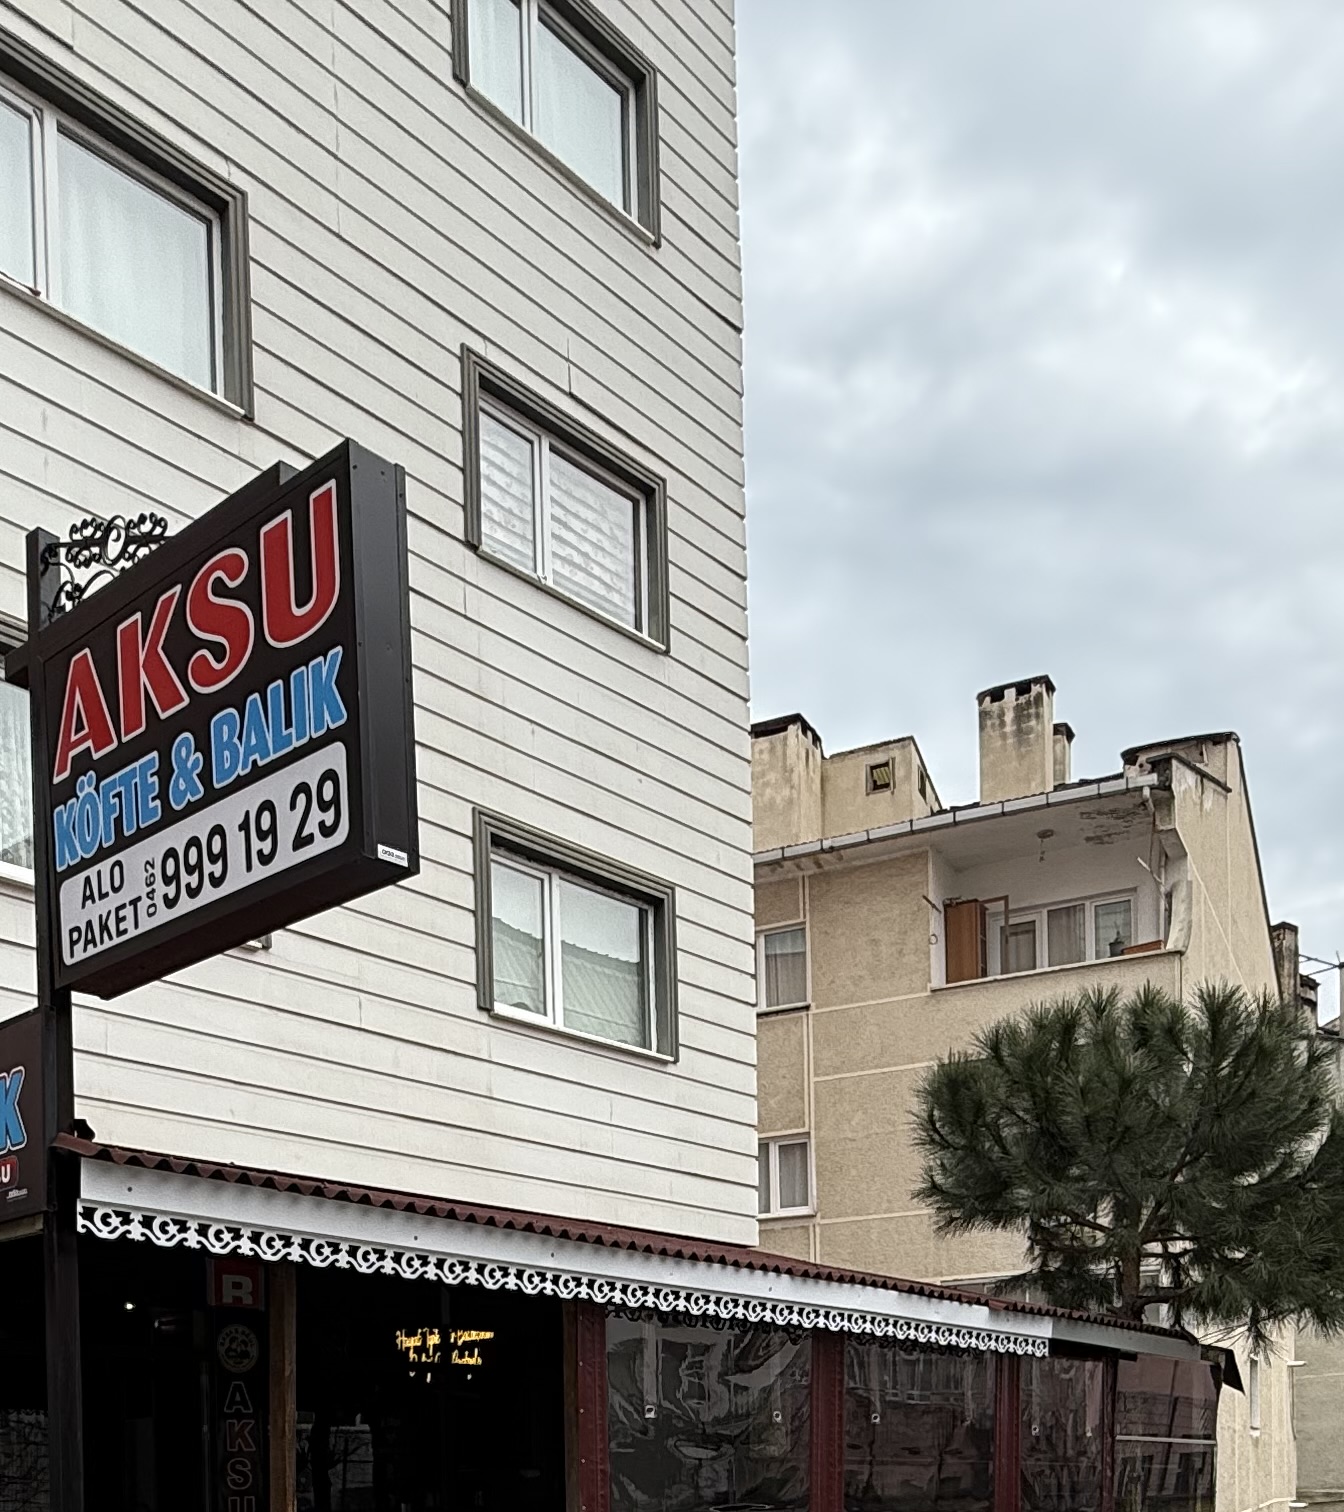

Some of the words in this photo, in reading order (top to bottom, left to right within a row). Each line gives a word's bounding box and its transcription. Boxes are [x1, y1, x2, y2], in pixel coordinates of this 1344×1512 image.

[53, 479, 342, 784] AKSU
[53, 750, 161, 873] KÖFTE
[170, 731, 203, 811] &
[210, 645, 348, 789] BALIK
[81, 859, 125, 910] ALO
[144, 857, 157, 918] 0462
[160, 823, 229, 910] 999
[238, 799, 278, 873] 19
[289, 768, 342, 852] 29
[68, 895, 143, 959] PAKET
